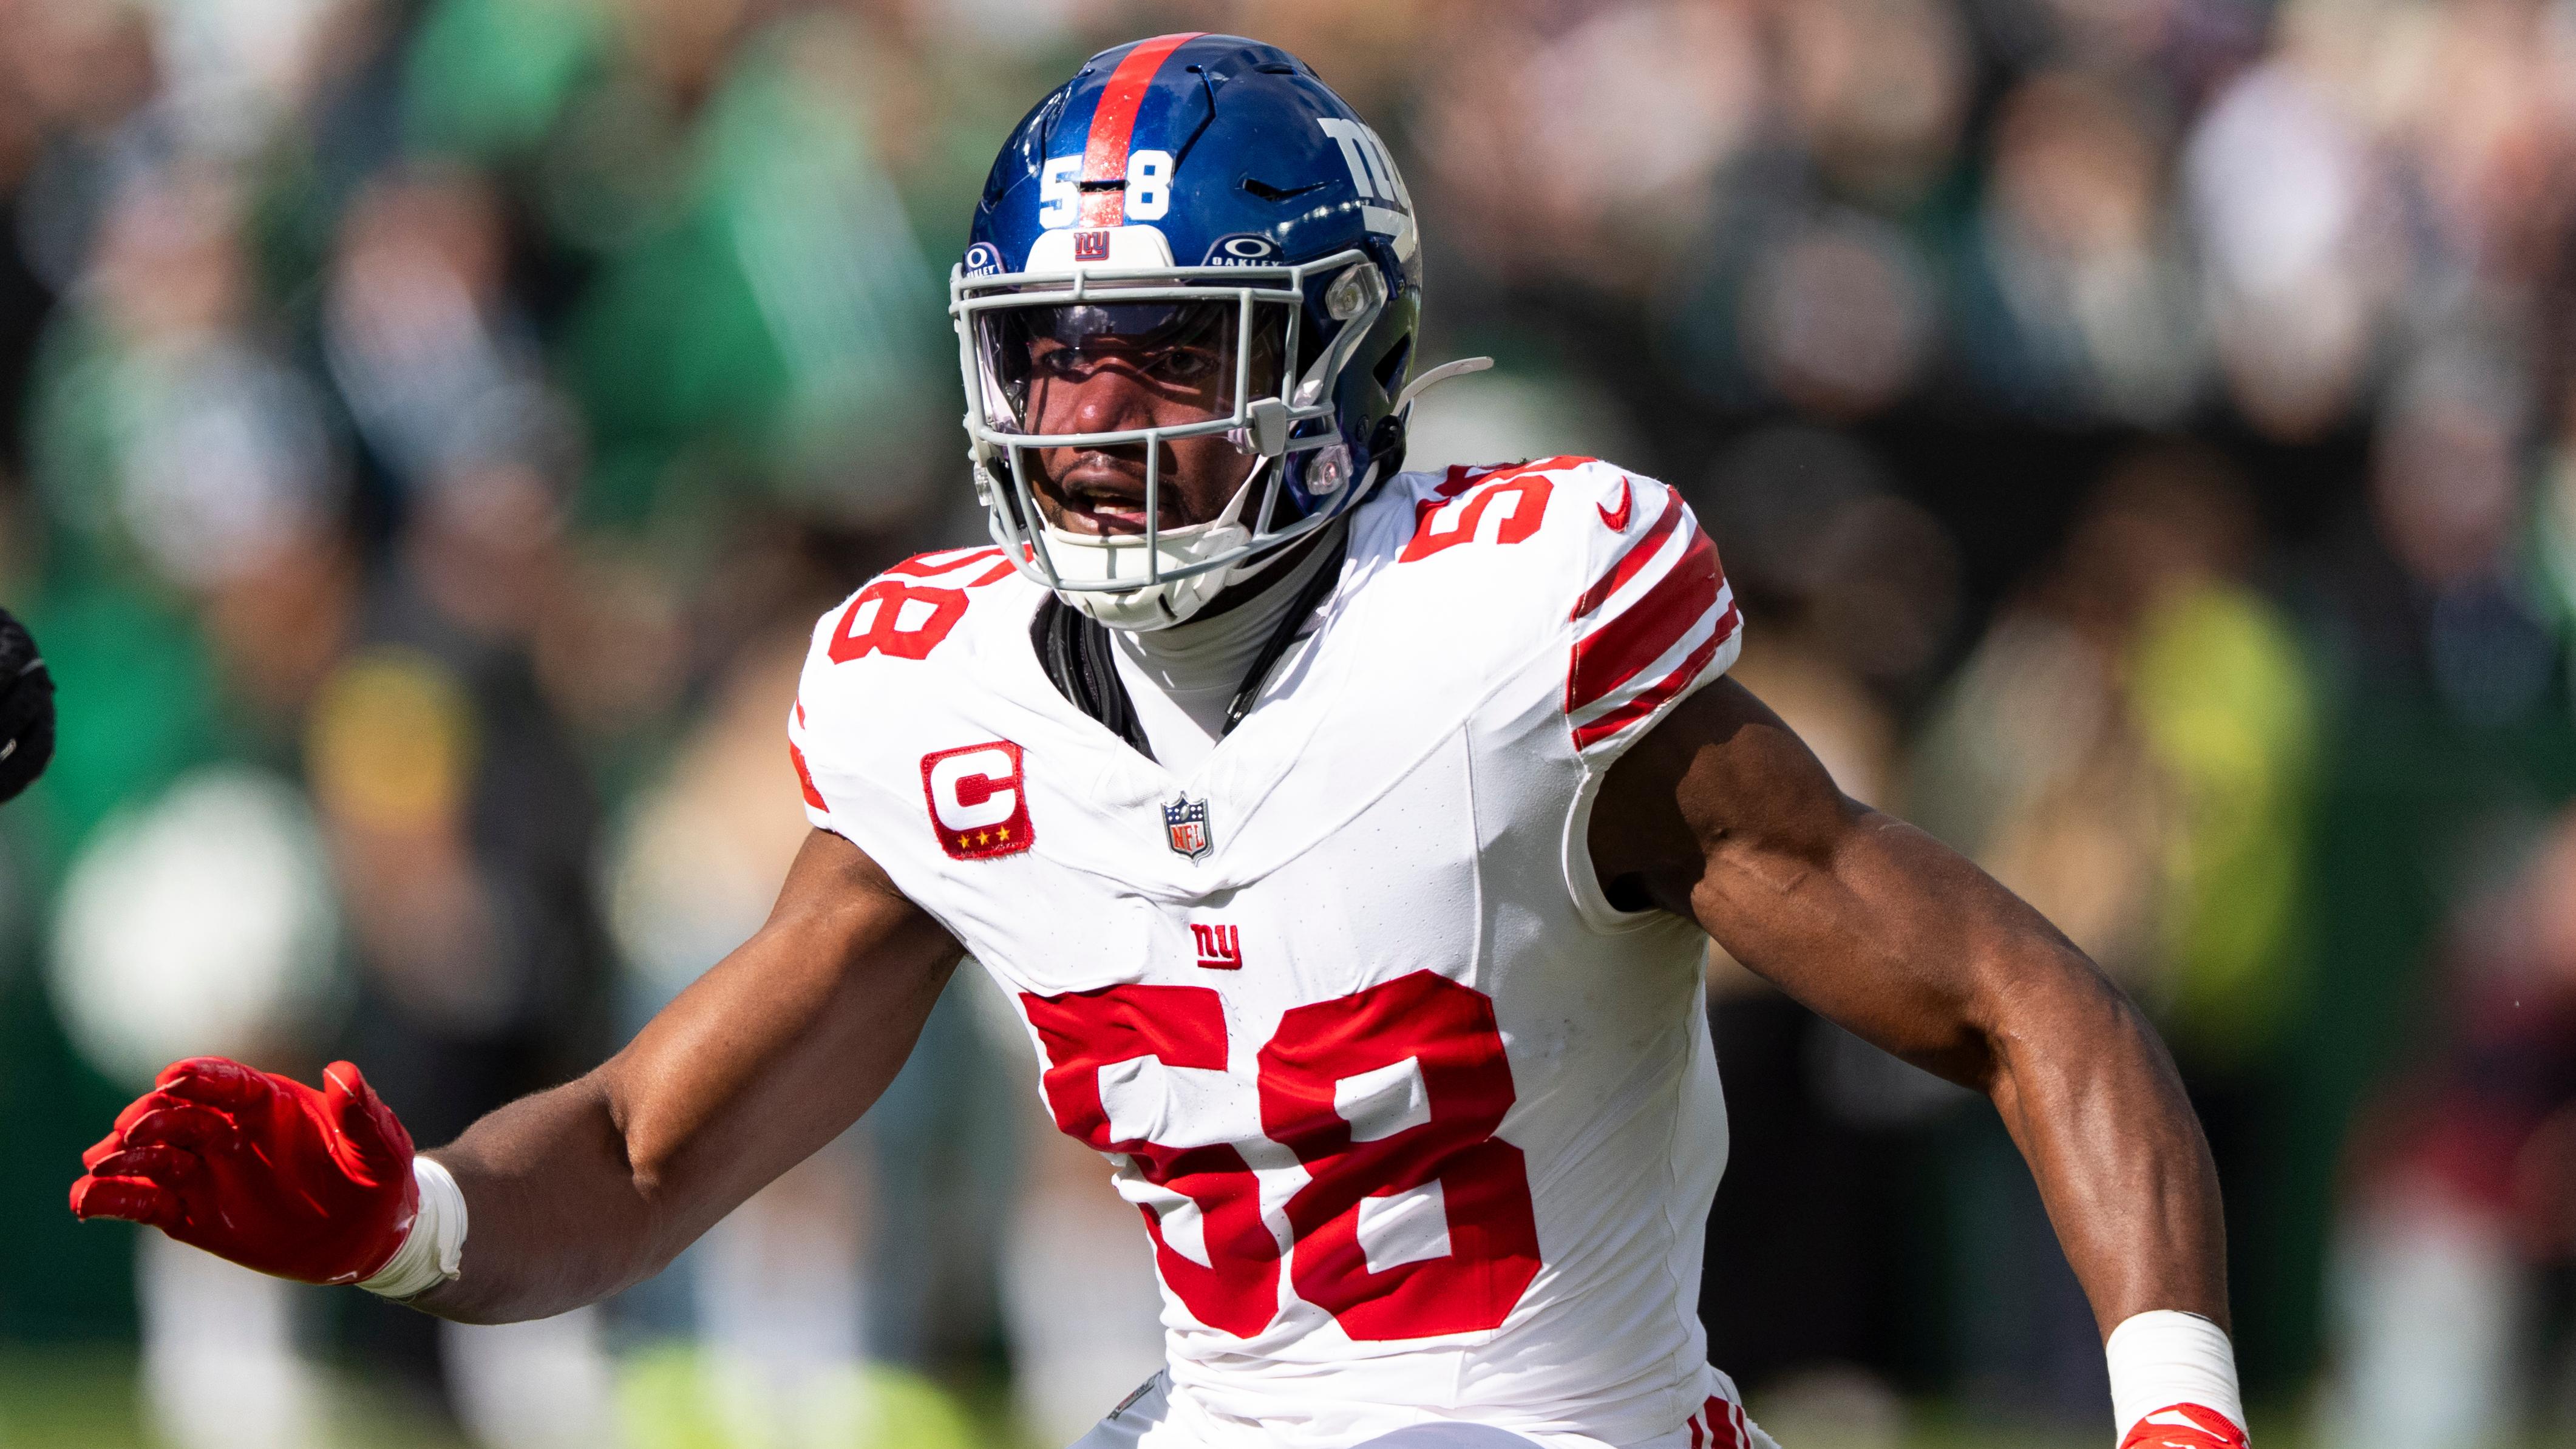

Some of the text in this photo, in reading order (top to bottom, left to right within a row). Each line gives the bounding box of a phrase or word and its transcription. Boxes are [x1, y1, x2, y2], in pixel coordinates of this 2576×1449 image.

[1212, 256, 1280, 266] OAKLEY
[930, 748, 1017, 832] C
[1171, 824, 1205, 852] NFL
[1020, 968, 1542, 1341] 58
